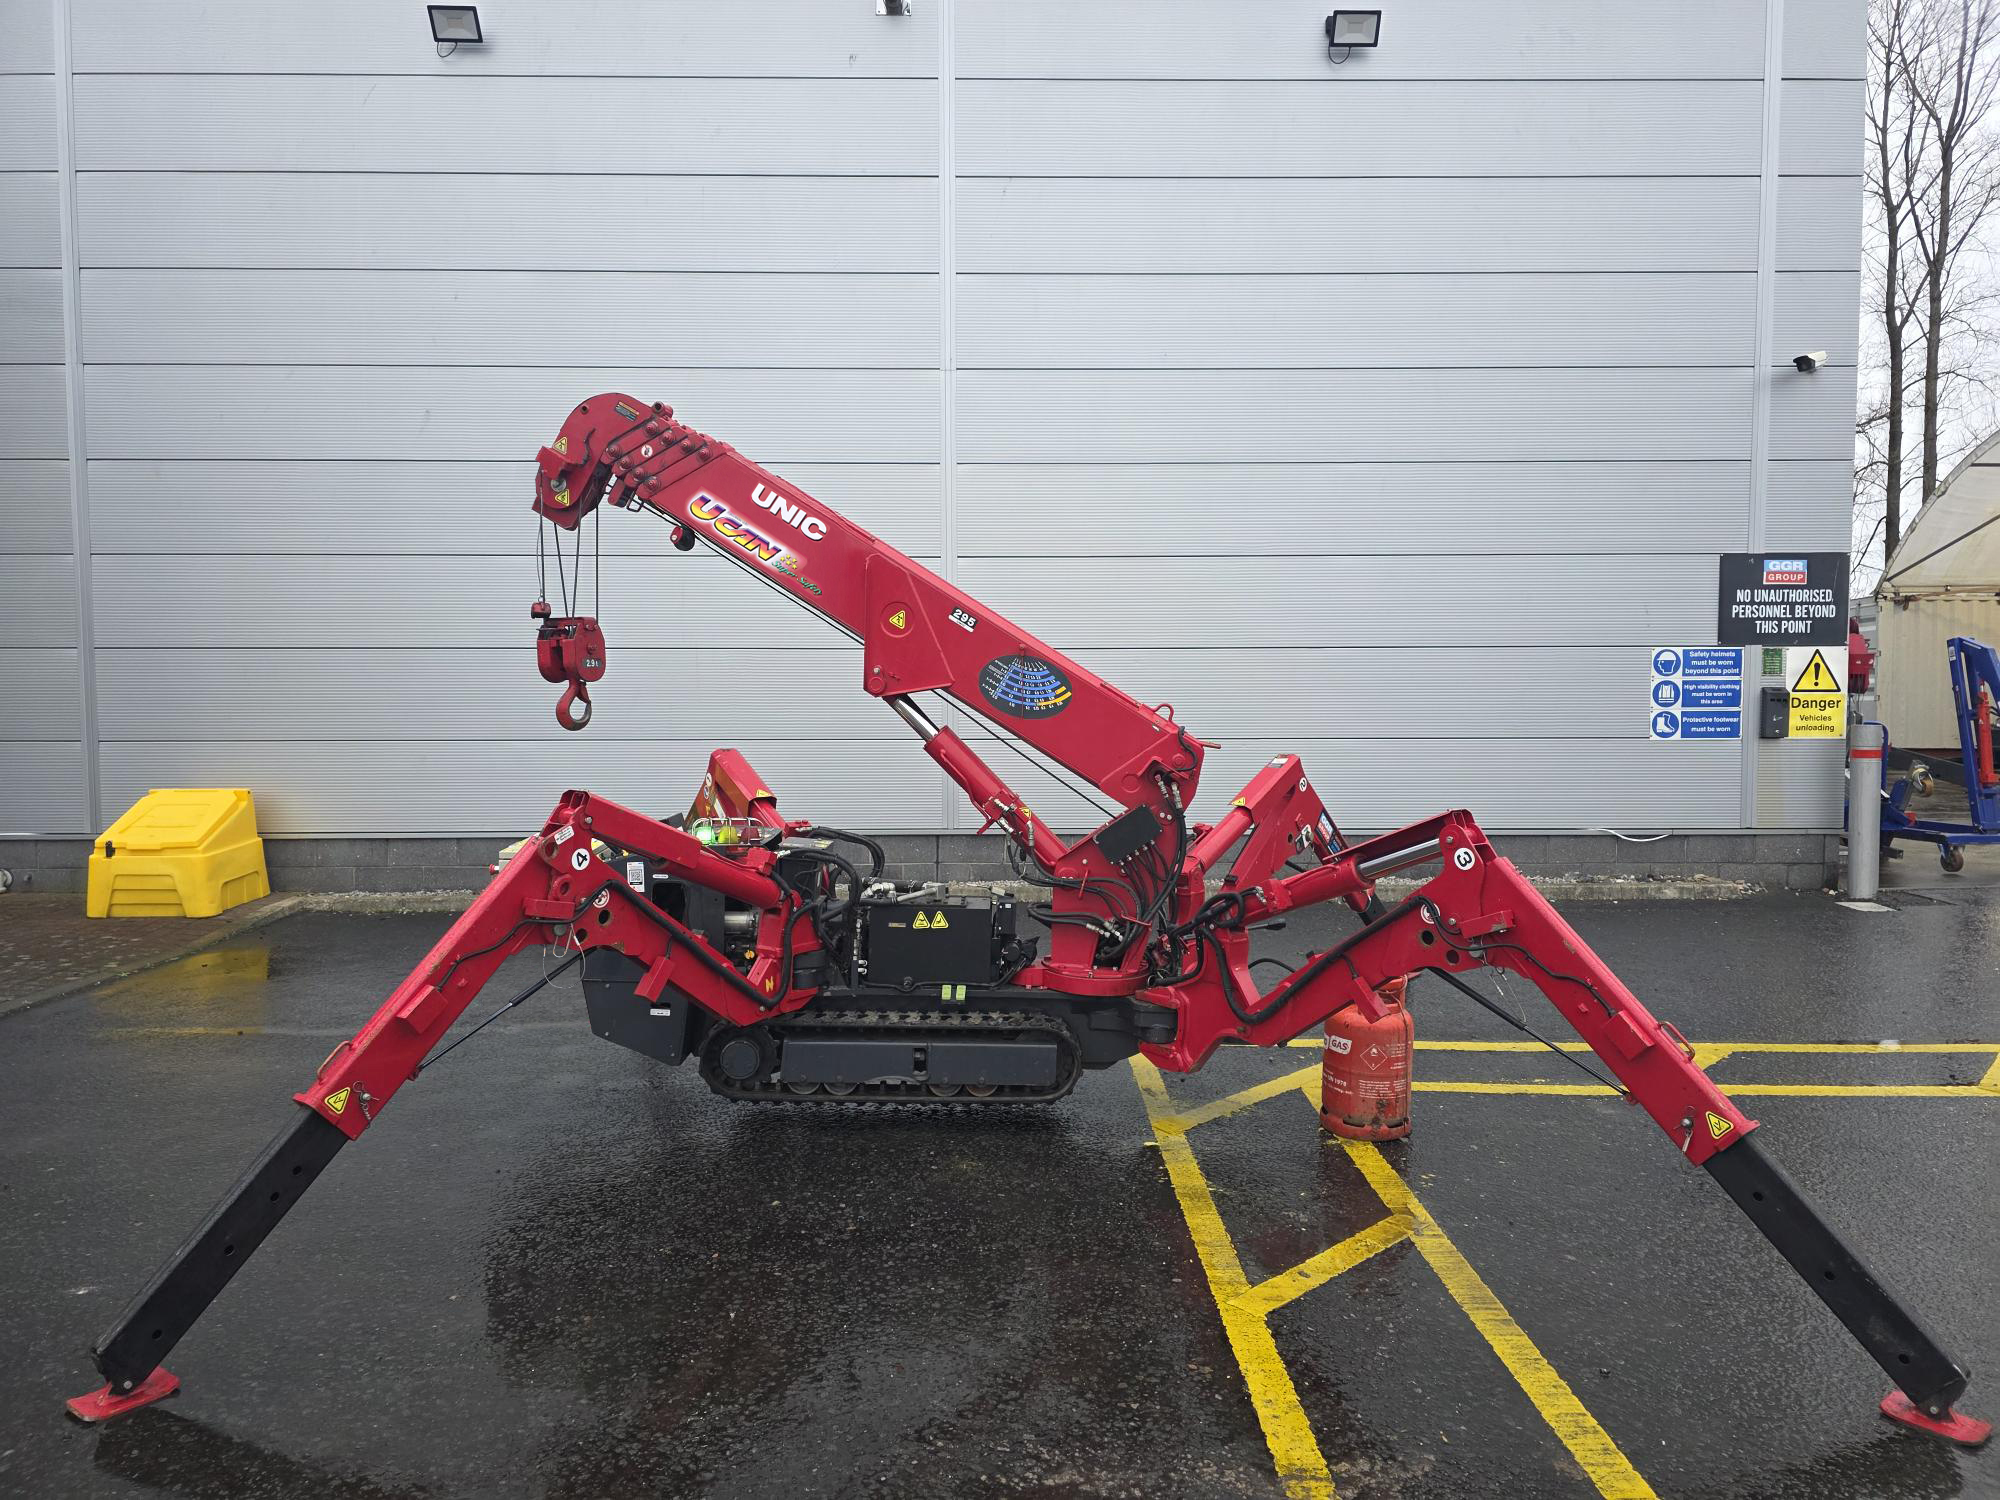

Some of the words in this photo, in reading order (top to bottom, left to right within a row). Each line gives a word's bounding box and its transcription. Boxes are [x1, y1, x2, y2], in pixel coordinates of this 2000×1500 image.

[751, 483, 827, 541] UNIC
[690, 494, 782, 561] UCAN
[1768, 561, 1804, 571] GGR
[1767, 573, 1804, 581] GROUP
[1736, 589, 1751, 603] NO
[1754, 589, 1833, 603] UNAUTHORISED
[953, 609, 976, 627] 295
[1732, 605, 1792, 618] PERSONNEL
[1795, 605, 1836, 618] BEYOND
[1755, 620, 1779, 634] THIS
[1781, 620, 1813, 634] POINT
[1791, 697, 1842, 712] Danger
[1795, 724, 1835, 733] unloading
[576, 852, 588, 867] 4
[1457, 851, 1473, 868] 3
[1331, 1039, 1349, 1051] GAS
